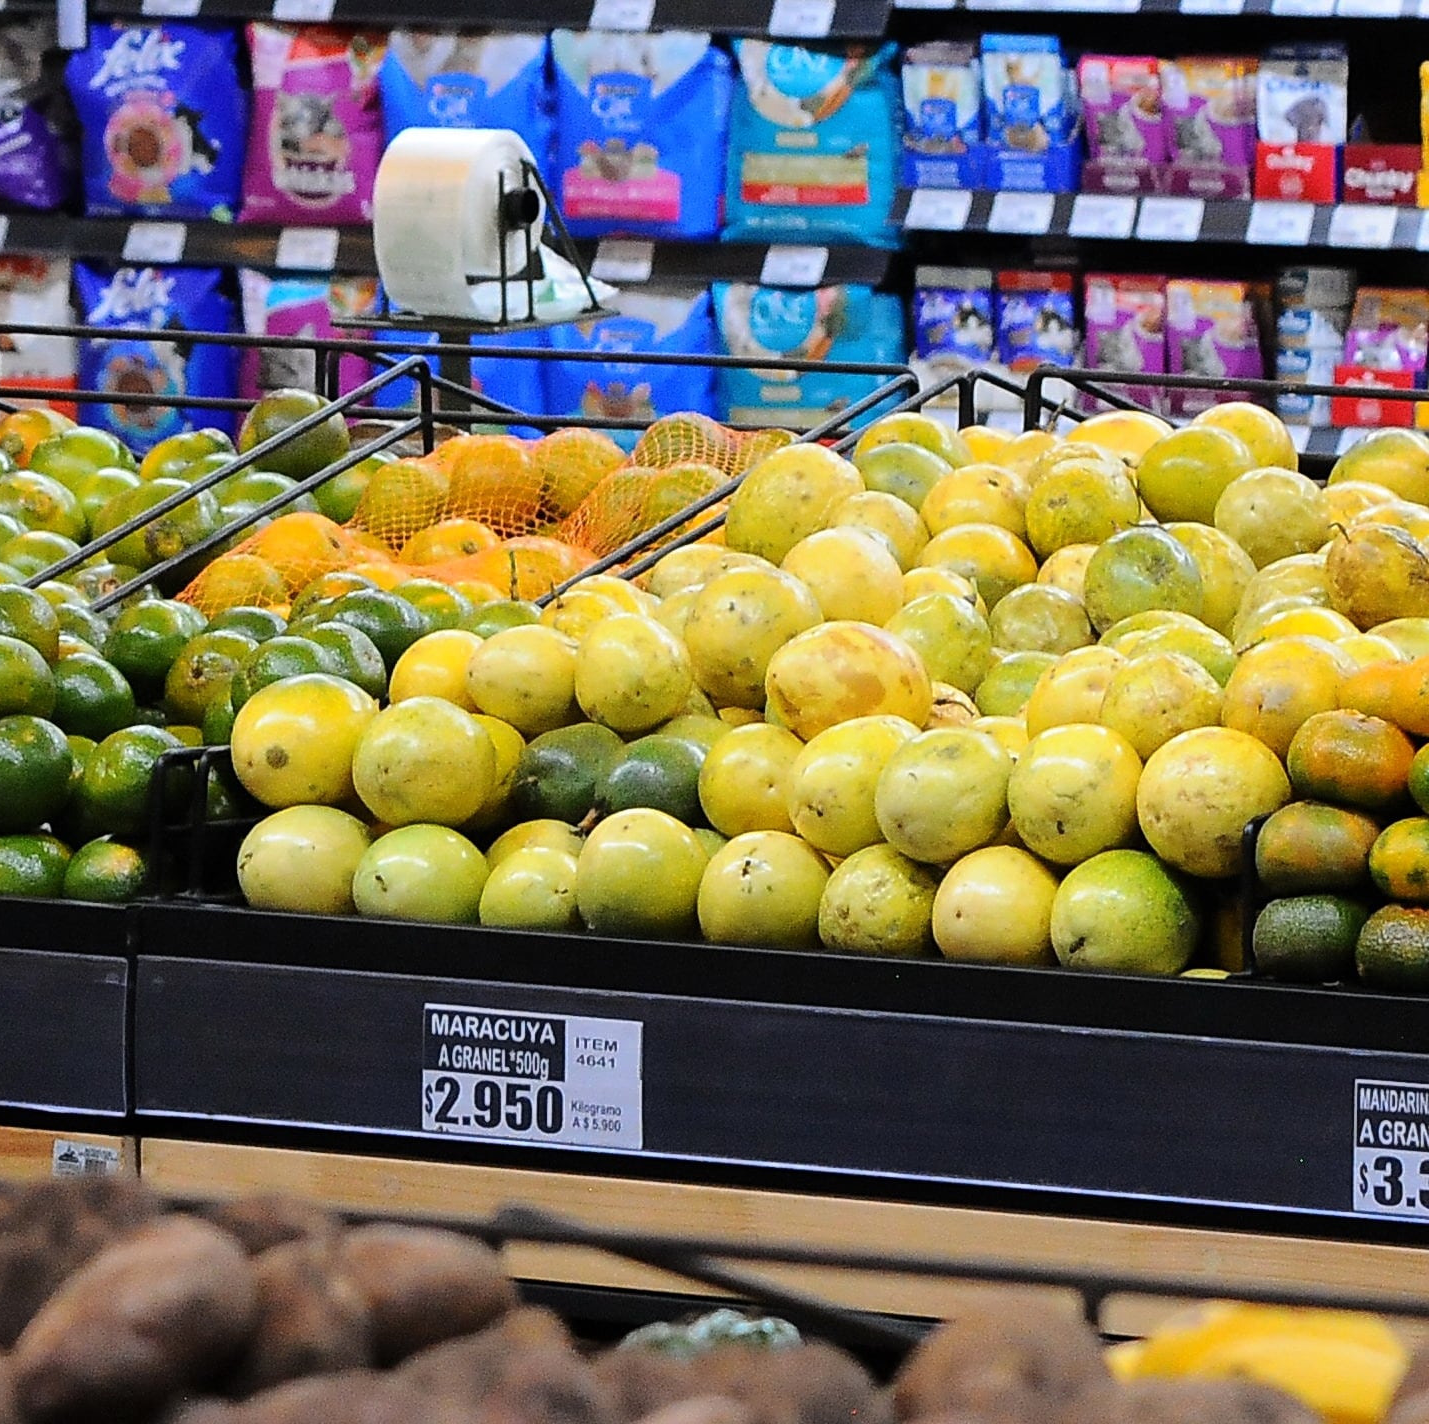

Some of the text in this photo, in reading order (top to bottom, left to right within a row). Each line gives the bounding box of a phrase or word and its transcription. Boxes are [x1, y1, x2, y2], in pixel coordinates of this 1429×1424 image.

[431, 1012, 556, 1045] MARACUYA
[438, 1043, 450, 1068] A
[575, 1036, 618, 1053] ITEM
[576, 1054, 616, 1069] 4641
[571, 1100, 622, 1117] Kilogramo
[1359, 1087, 1429, 1115] MANDARIN
[1359, 1117, 1374, 1144] A
